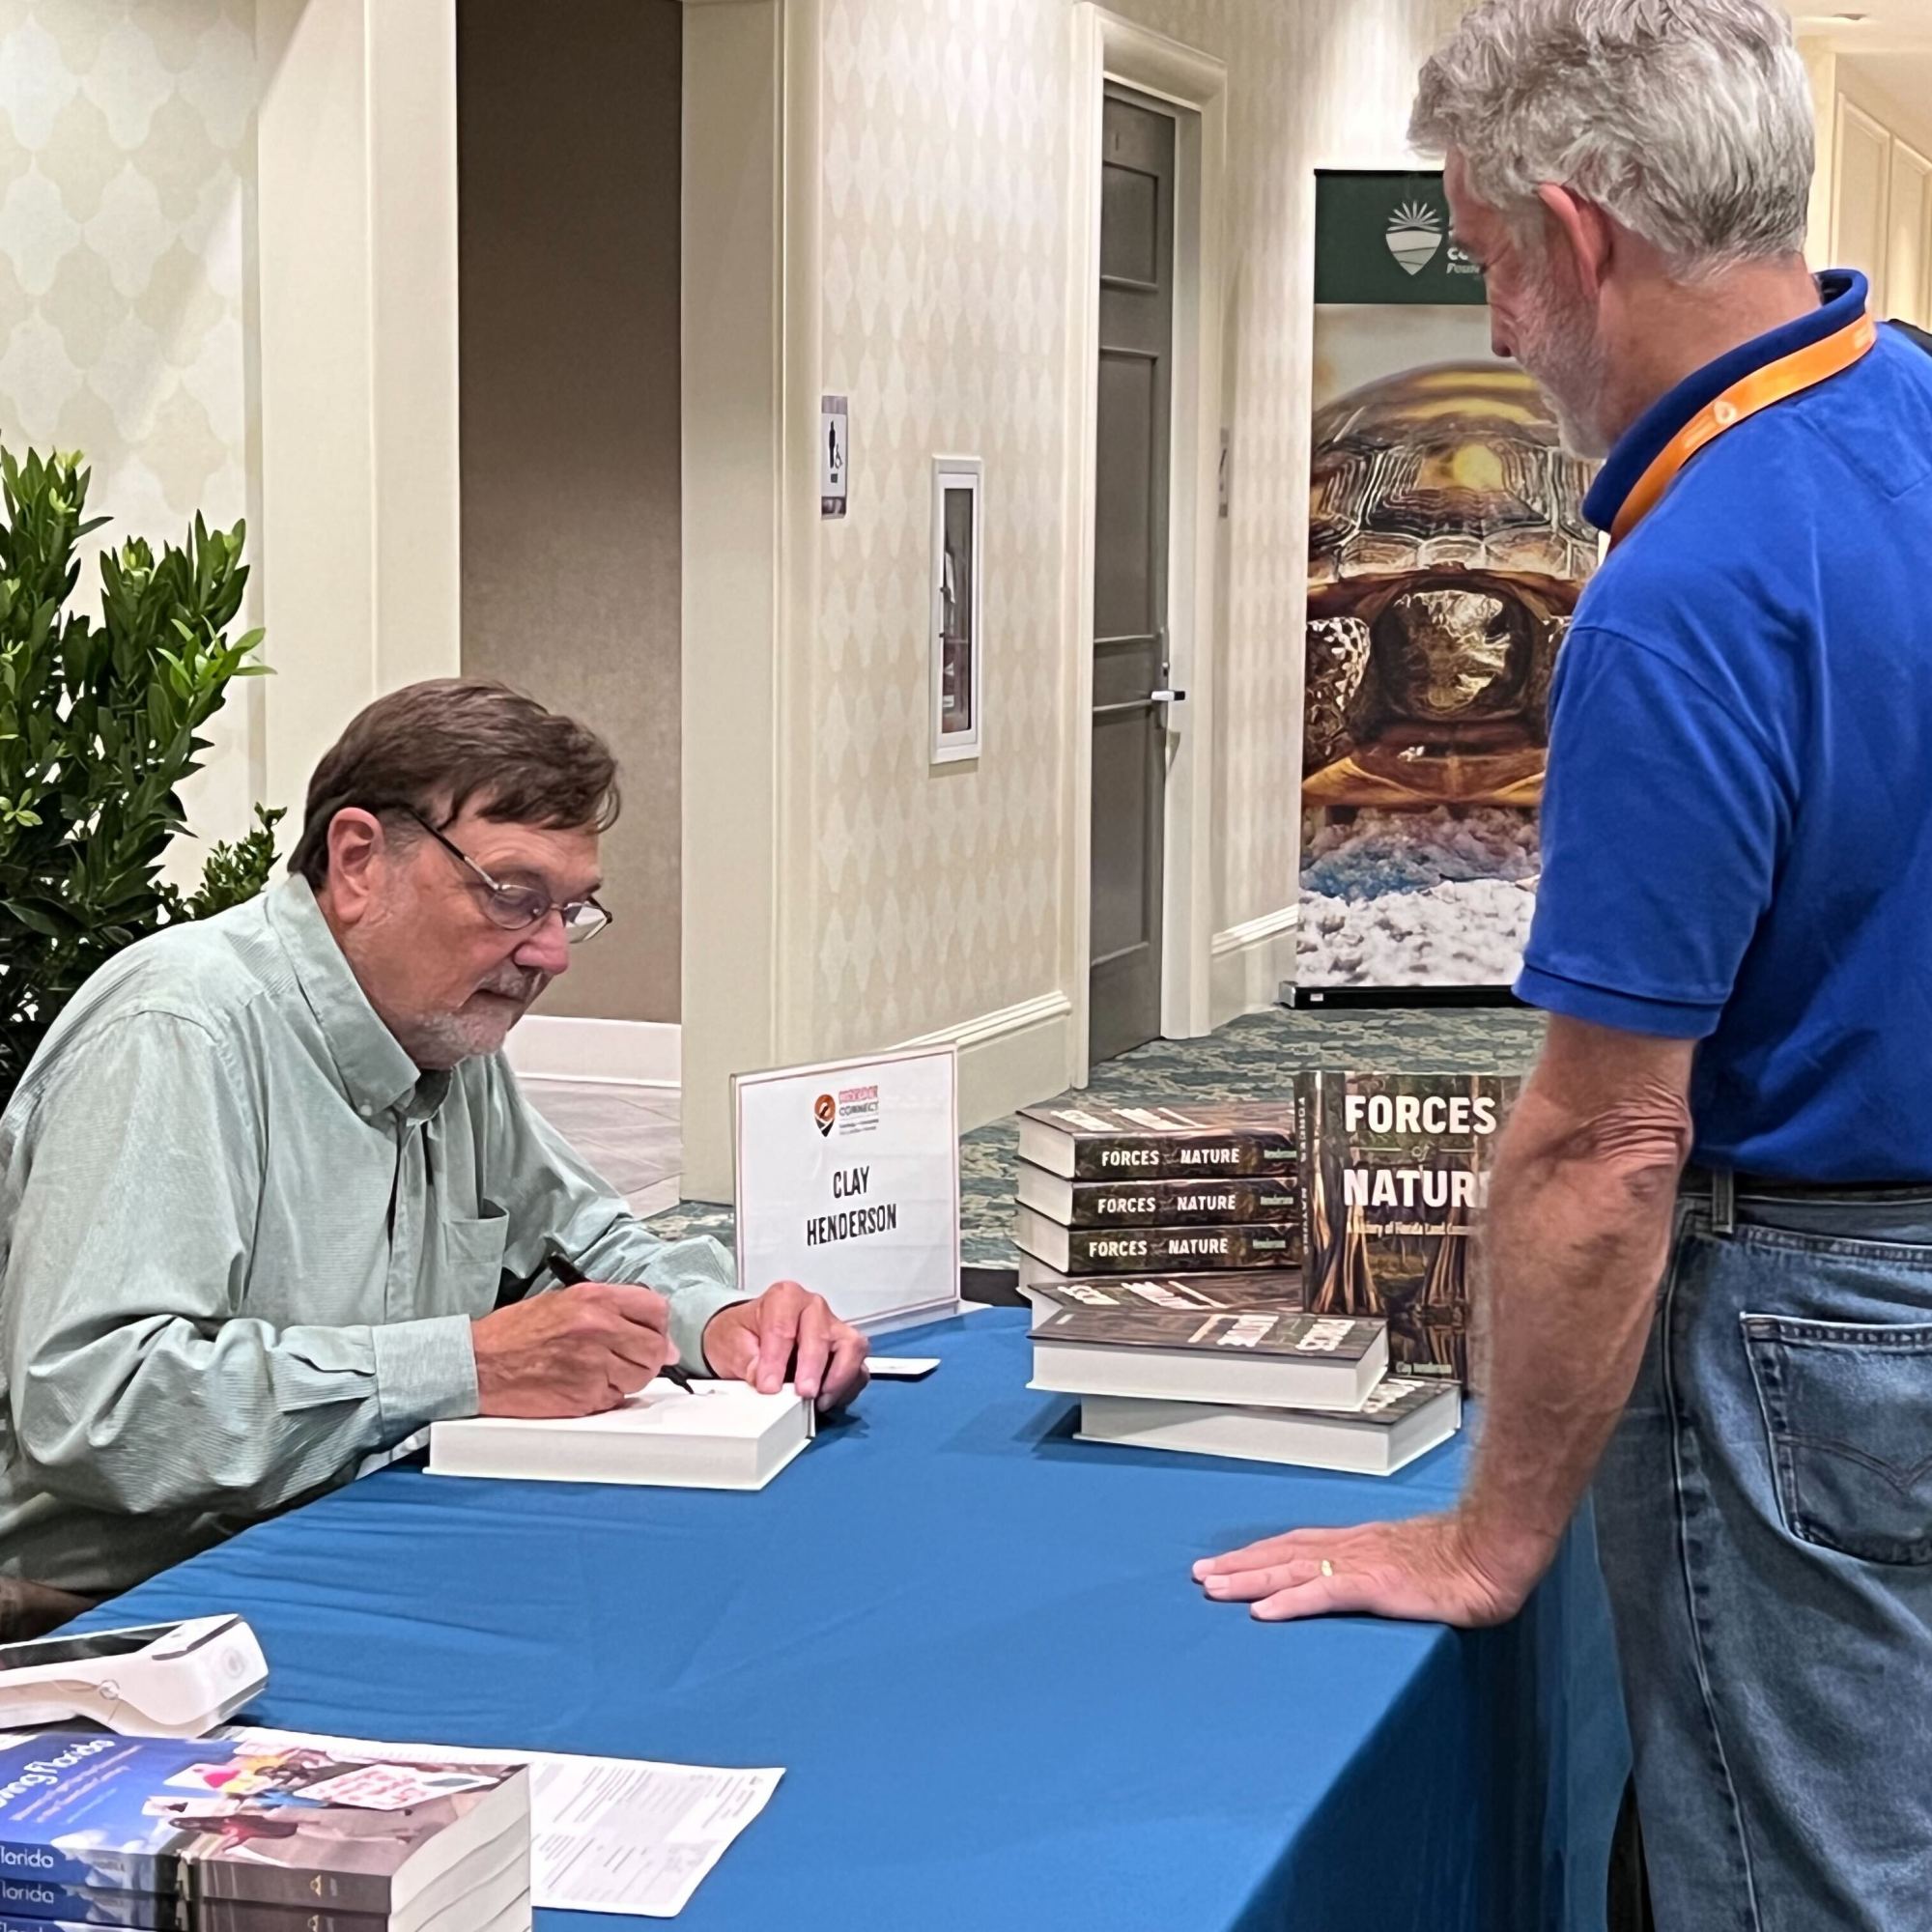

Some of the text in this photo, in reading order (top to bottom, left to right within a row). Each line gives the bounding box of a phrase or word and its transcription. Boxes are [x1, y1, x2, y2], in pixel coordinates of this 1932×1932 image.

[1345, 1094, 1496, 1134] FORCES
[1101, 1149, 1240, 1167] FORCES NATURE
[833, 1165, 869, 1199] CLAY
[1097, 1194, 1236, 1214] FORCES NATURE
[807, 1204, 897, 1246] HENDERSON
[1089, 1238, 1229, 1257] FORCES NATURE
